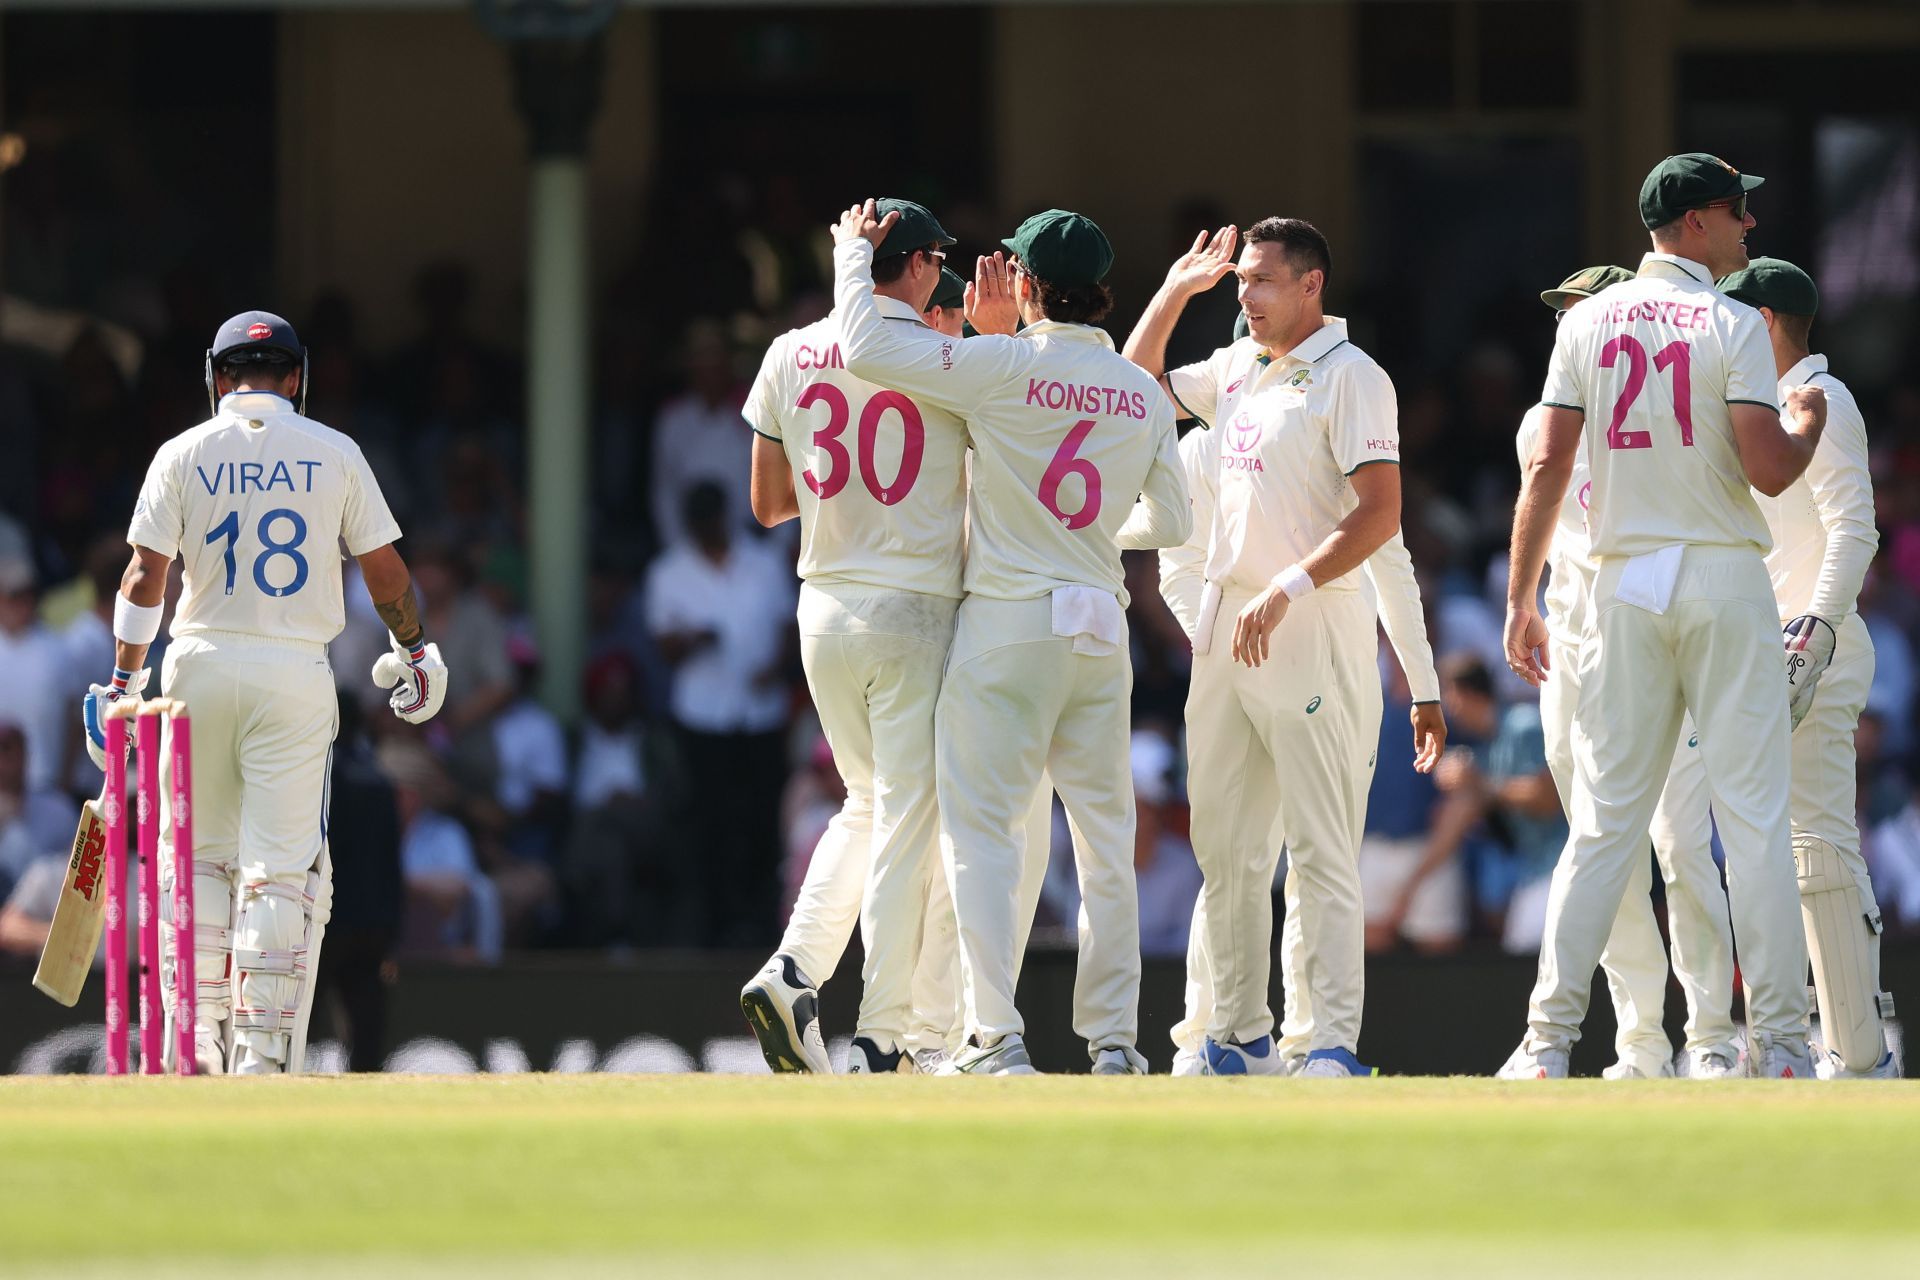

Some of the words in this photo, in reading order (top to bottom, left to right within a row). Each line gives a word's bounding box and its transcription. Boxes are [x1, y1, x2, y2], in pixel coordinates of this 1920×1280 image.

[942, 340, 954, 371] Tech
[1598, 333, 1694, 450] 21
[1025, 378, 1147, 420] KONSTAS
[196, 460, 323, 496] VIRAT
[795, 382, 925, 507] 30
[1037, 419, 1103, 531] 6
[205, 508, 309, 598] 18
[70, 830, 87, 870] Genius
[73, 816, 107, 902] MRF
